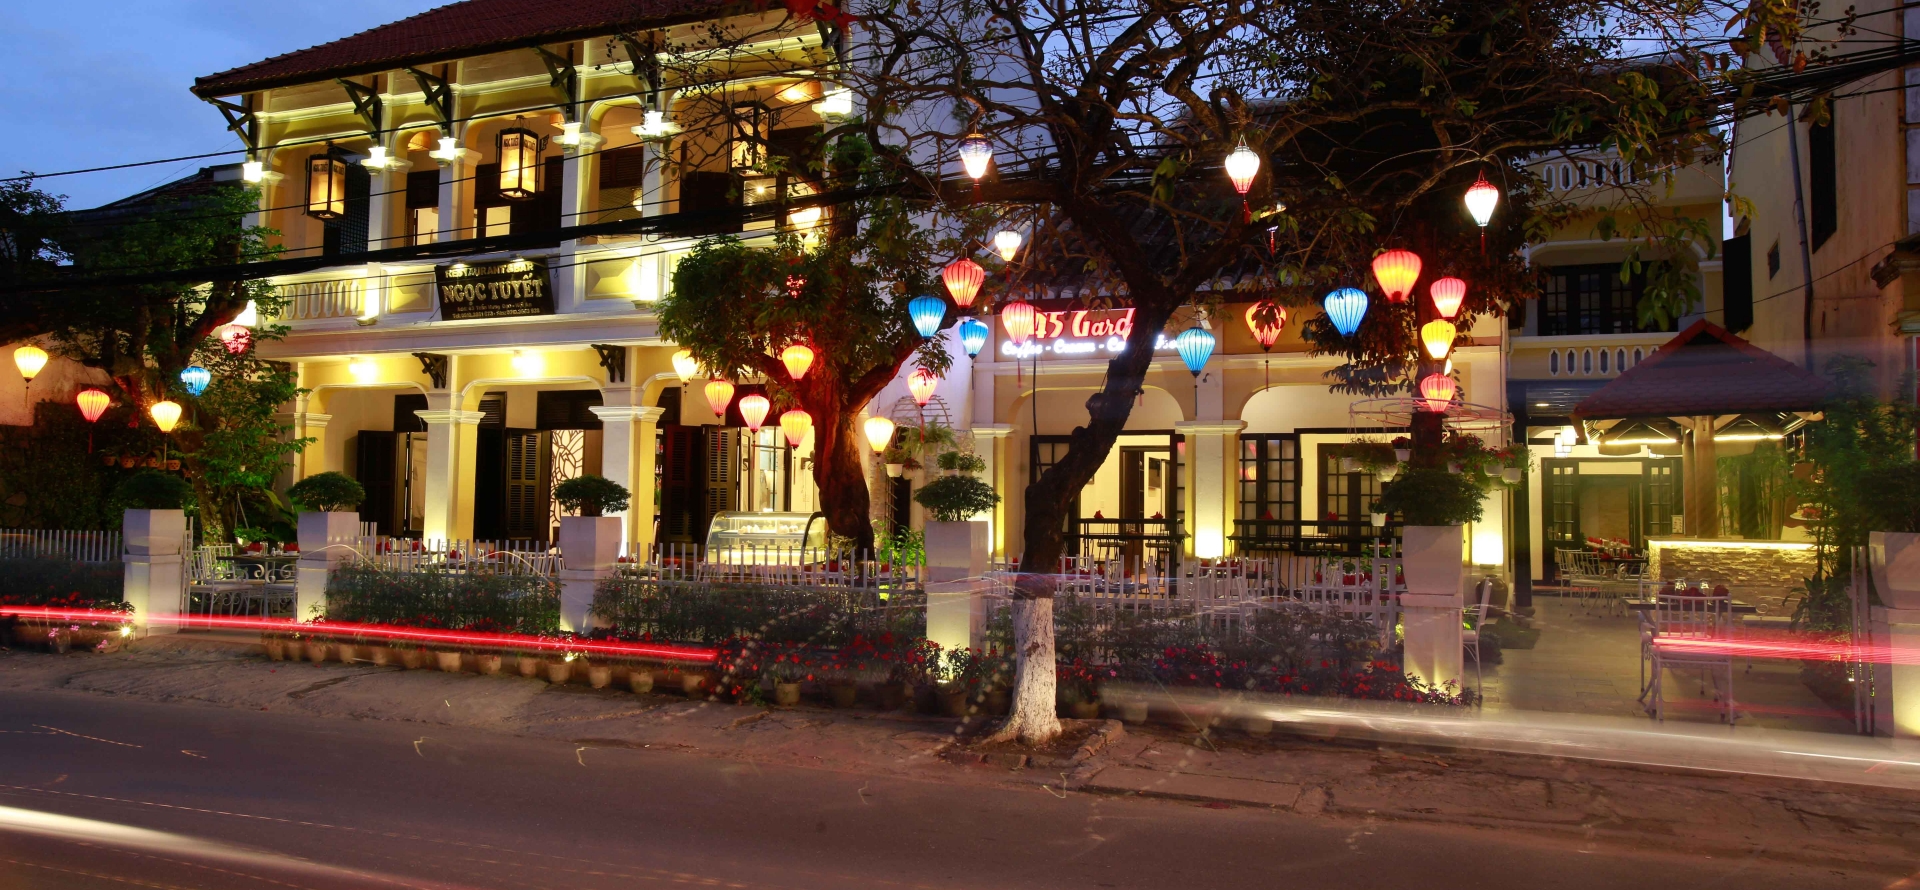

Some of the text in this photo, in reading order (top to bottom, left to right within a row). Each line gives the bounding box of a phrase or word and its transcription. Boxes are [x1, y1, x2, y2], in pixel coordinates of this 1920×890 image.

[442, 272, 543, 306] NGỌC TUYẾT
[1028, 308, 1137, 338] 45 Gard
[1002, 338, 1043, 358] Coffee
